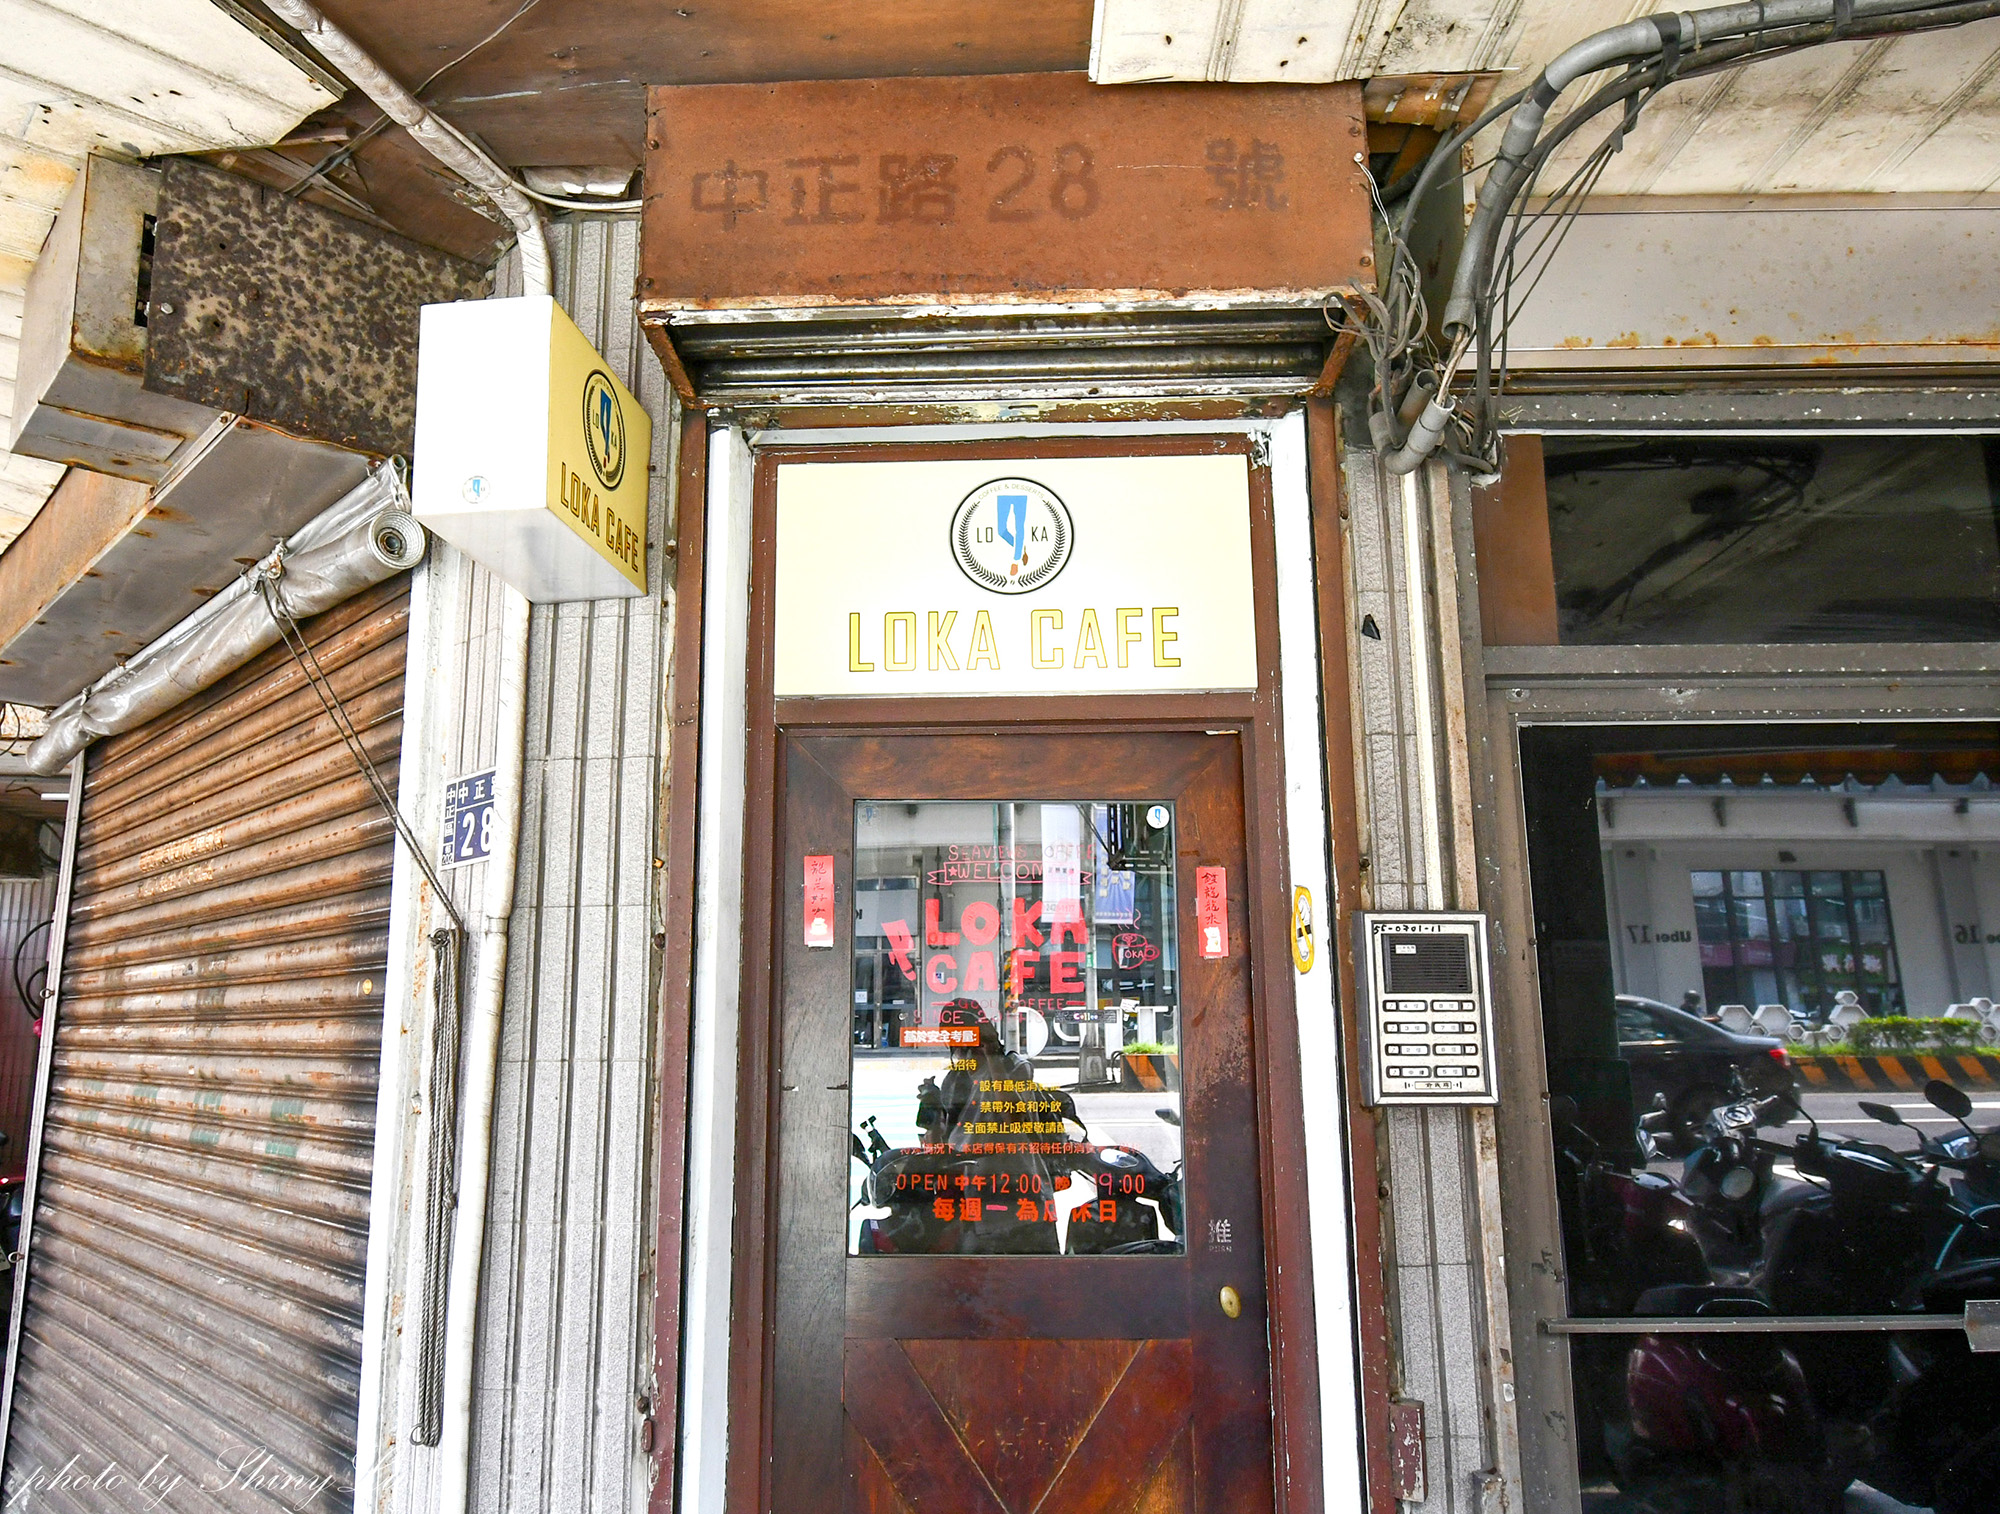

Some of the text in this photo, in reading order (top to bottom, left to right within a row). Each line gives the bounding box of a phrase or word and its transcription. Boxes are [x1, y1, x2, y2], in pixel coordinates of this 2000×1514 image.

[1012, 483, 1045, 500] DESSERTS
[560, 461, 639, 573] LOKA CAFE
[976, 525, 1049, 544] LO KA
[849, 606, 1182, 673] LOKA CAFE
[460, 806, 496, 858] 28
[925, 898, 1090, 948] LOKA
[925, 951, 1086, 994] CAFE
[1009, 998, 1065, 1010] COFFEE
[913, 1010, 965, 1025] SINCE
[979, 1101, 1062, 1113] 禁帶外食和外飲
[896, 1173, 948, 1191] OPEN
[1208, 1218, 1232, 1243] 推
